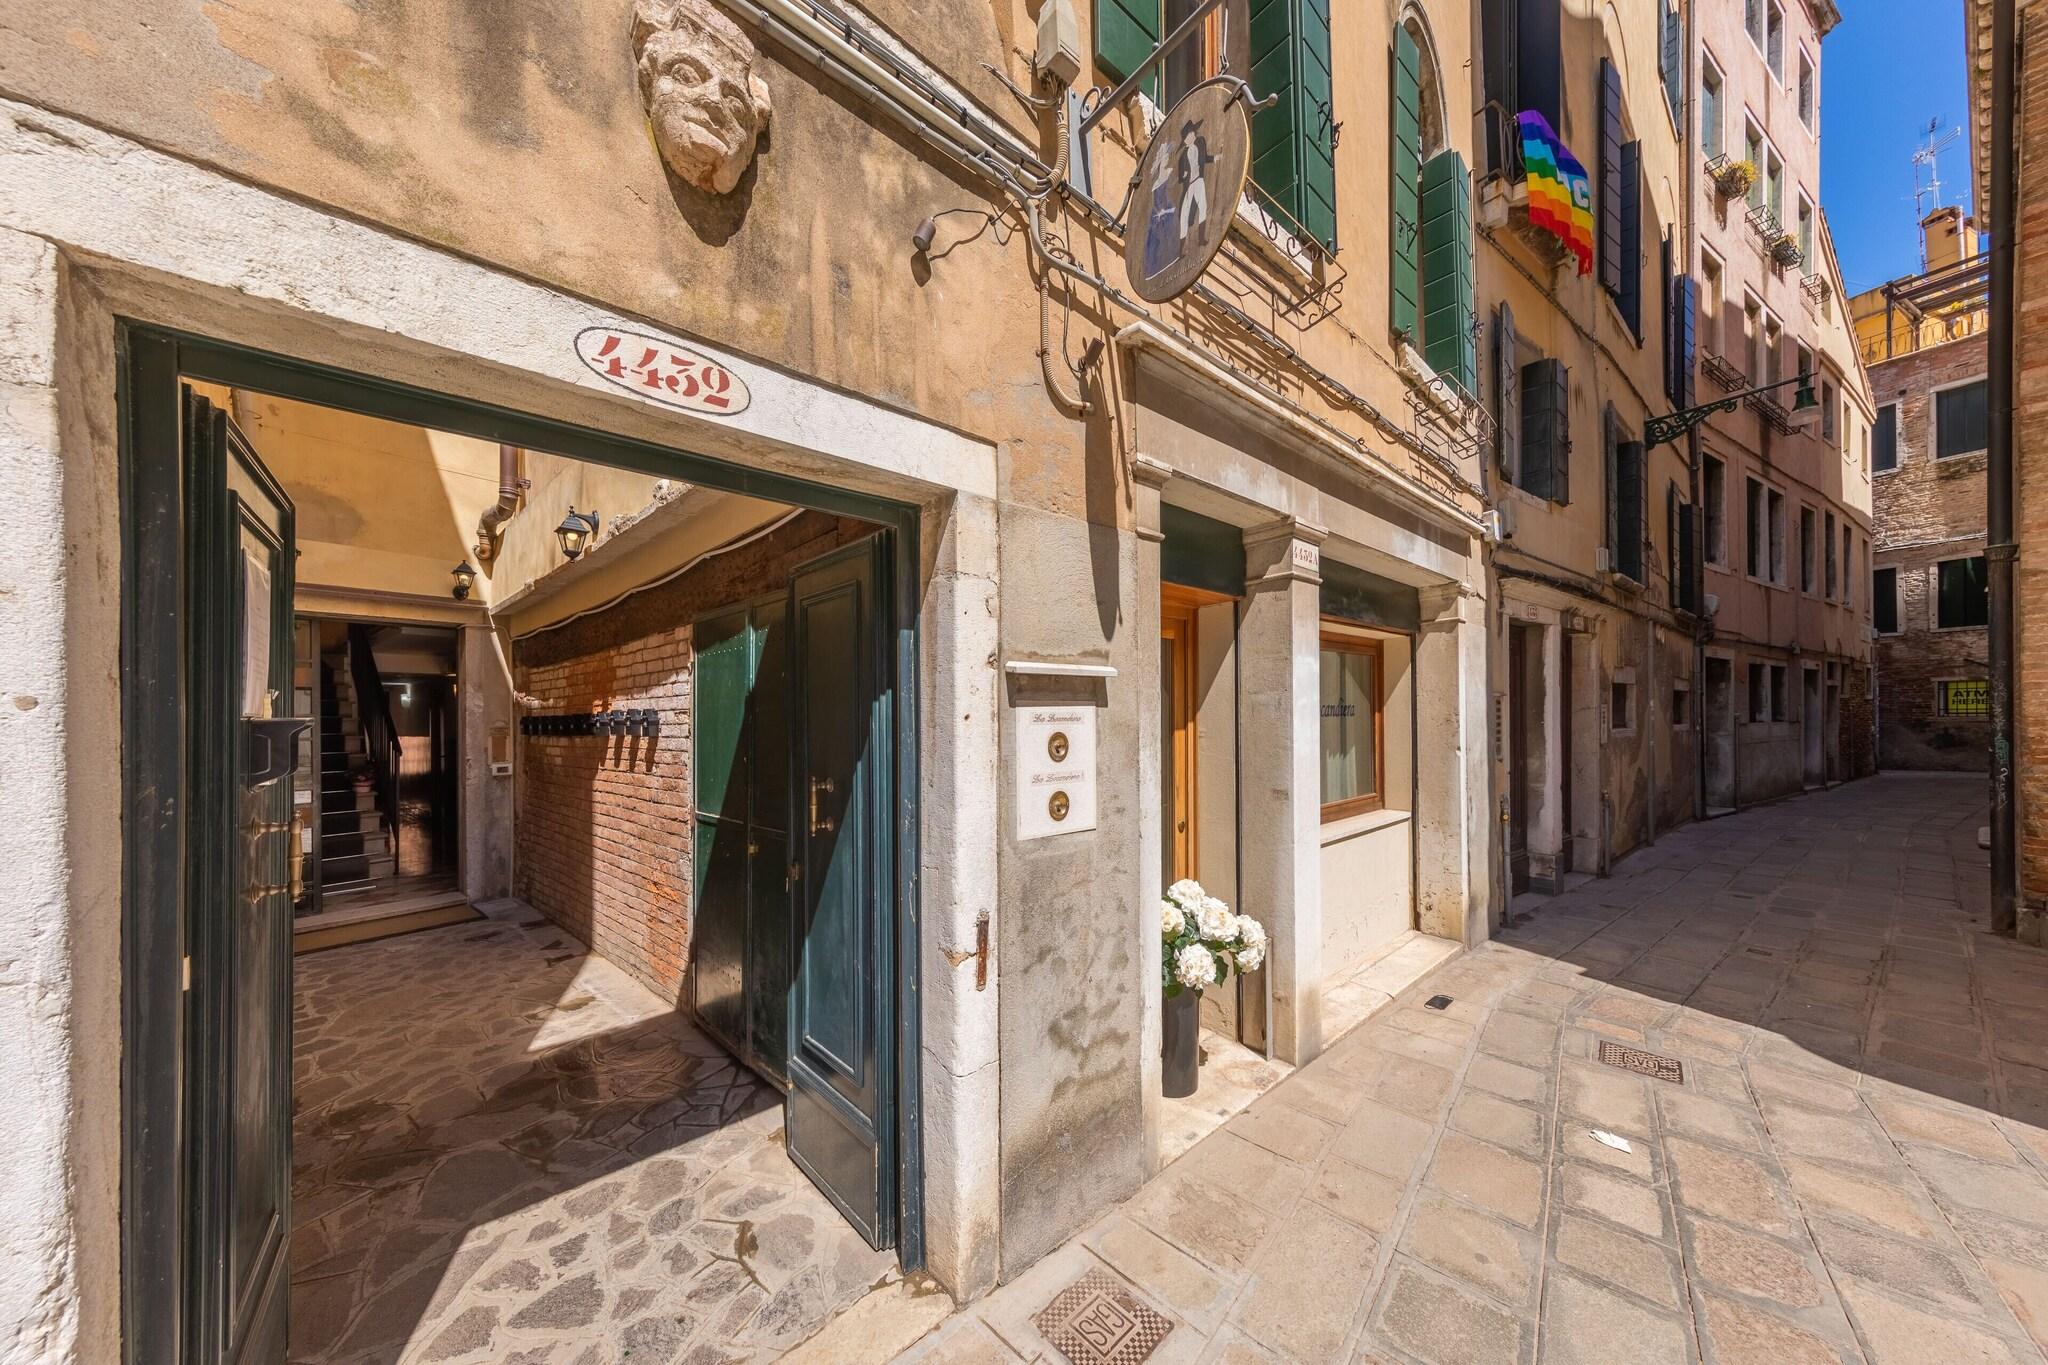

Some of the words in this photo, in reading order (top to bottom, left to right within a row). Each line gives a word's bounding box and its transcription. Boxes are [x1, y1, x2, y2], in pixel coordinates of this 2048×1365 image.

[591, 335, 730, 408] 4432
[1320, 697, 1355, 718] candiera
[1952, 690, 1989, 698] ATM
[1078, 1303, 1125, 1346] GAS
